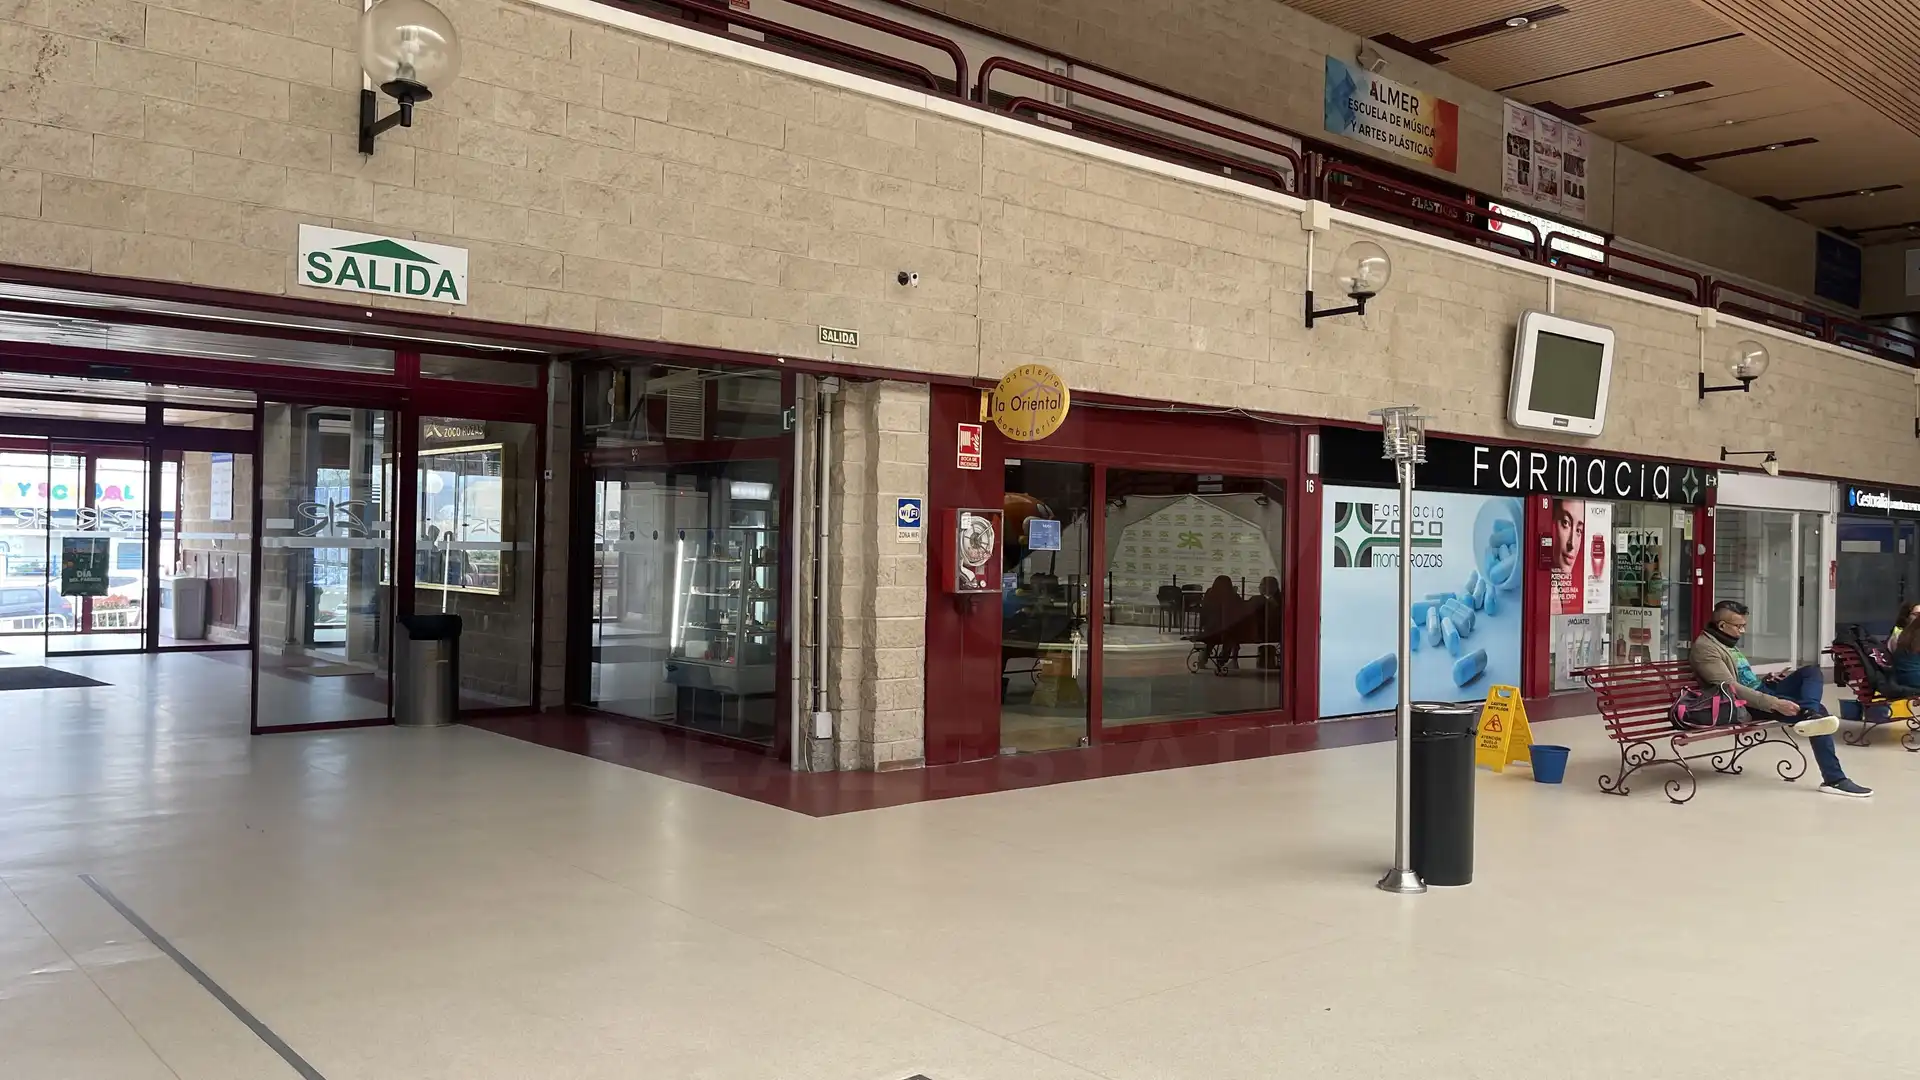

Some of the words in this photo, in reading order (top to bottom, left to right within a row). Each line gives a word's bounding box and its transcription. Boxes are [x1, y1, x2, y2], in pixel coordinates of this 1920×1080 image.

[1348, 97, 1388, 122] ESCUELA
[1389, 112, 1402, 128] DE
[1403, 118, 1436, 140] MÚSICA
[1350, 119, 1357, 133] Y
[1358, 123, 1388, 143] ARTES
[1388, 134, 1435, 158] PLÁSTICAS
[306, 251, 460, 300] SALIDA
[822, 329, 856, 345] SALIDA
[995, 396, 1005, 412] la
[1010, 392, 1062, 412] Oriental
[443, 426, 461, 438] ZOCO
[1306, 479, 1315, 493] 16
[1373, 503, 1444, 519] FaRacia
[1542, 498, 1549, 509] 18
[1590, 507, 1606, 516] VICHY
[1373, 518, 1443, 536] ZOCO
